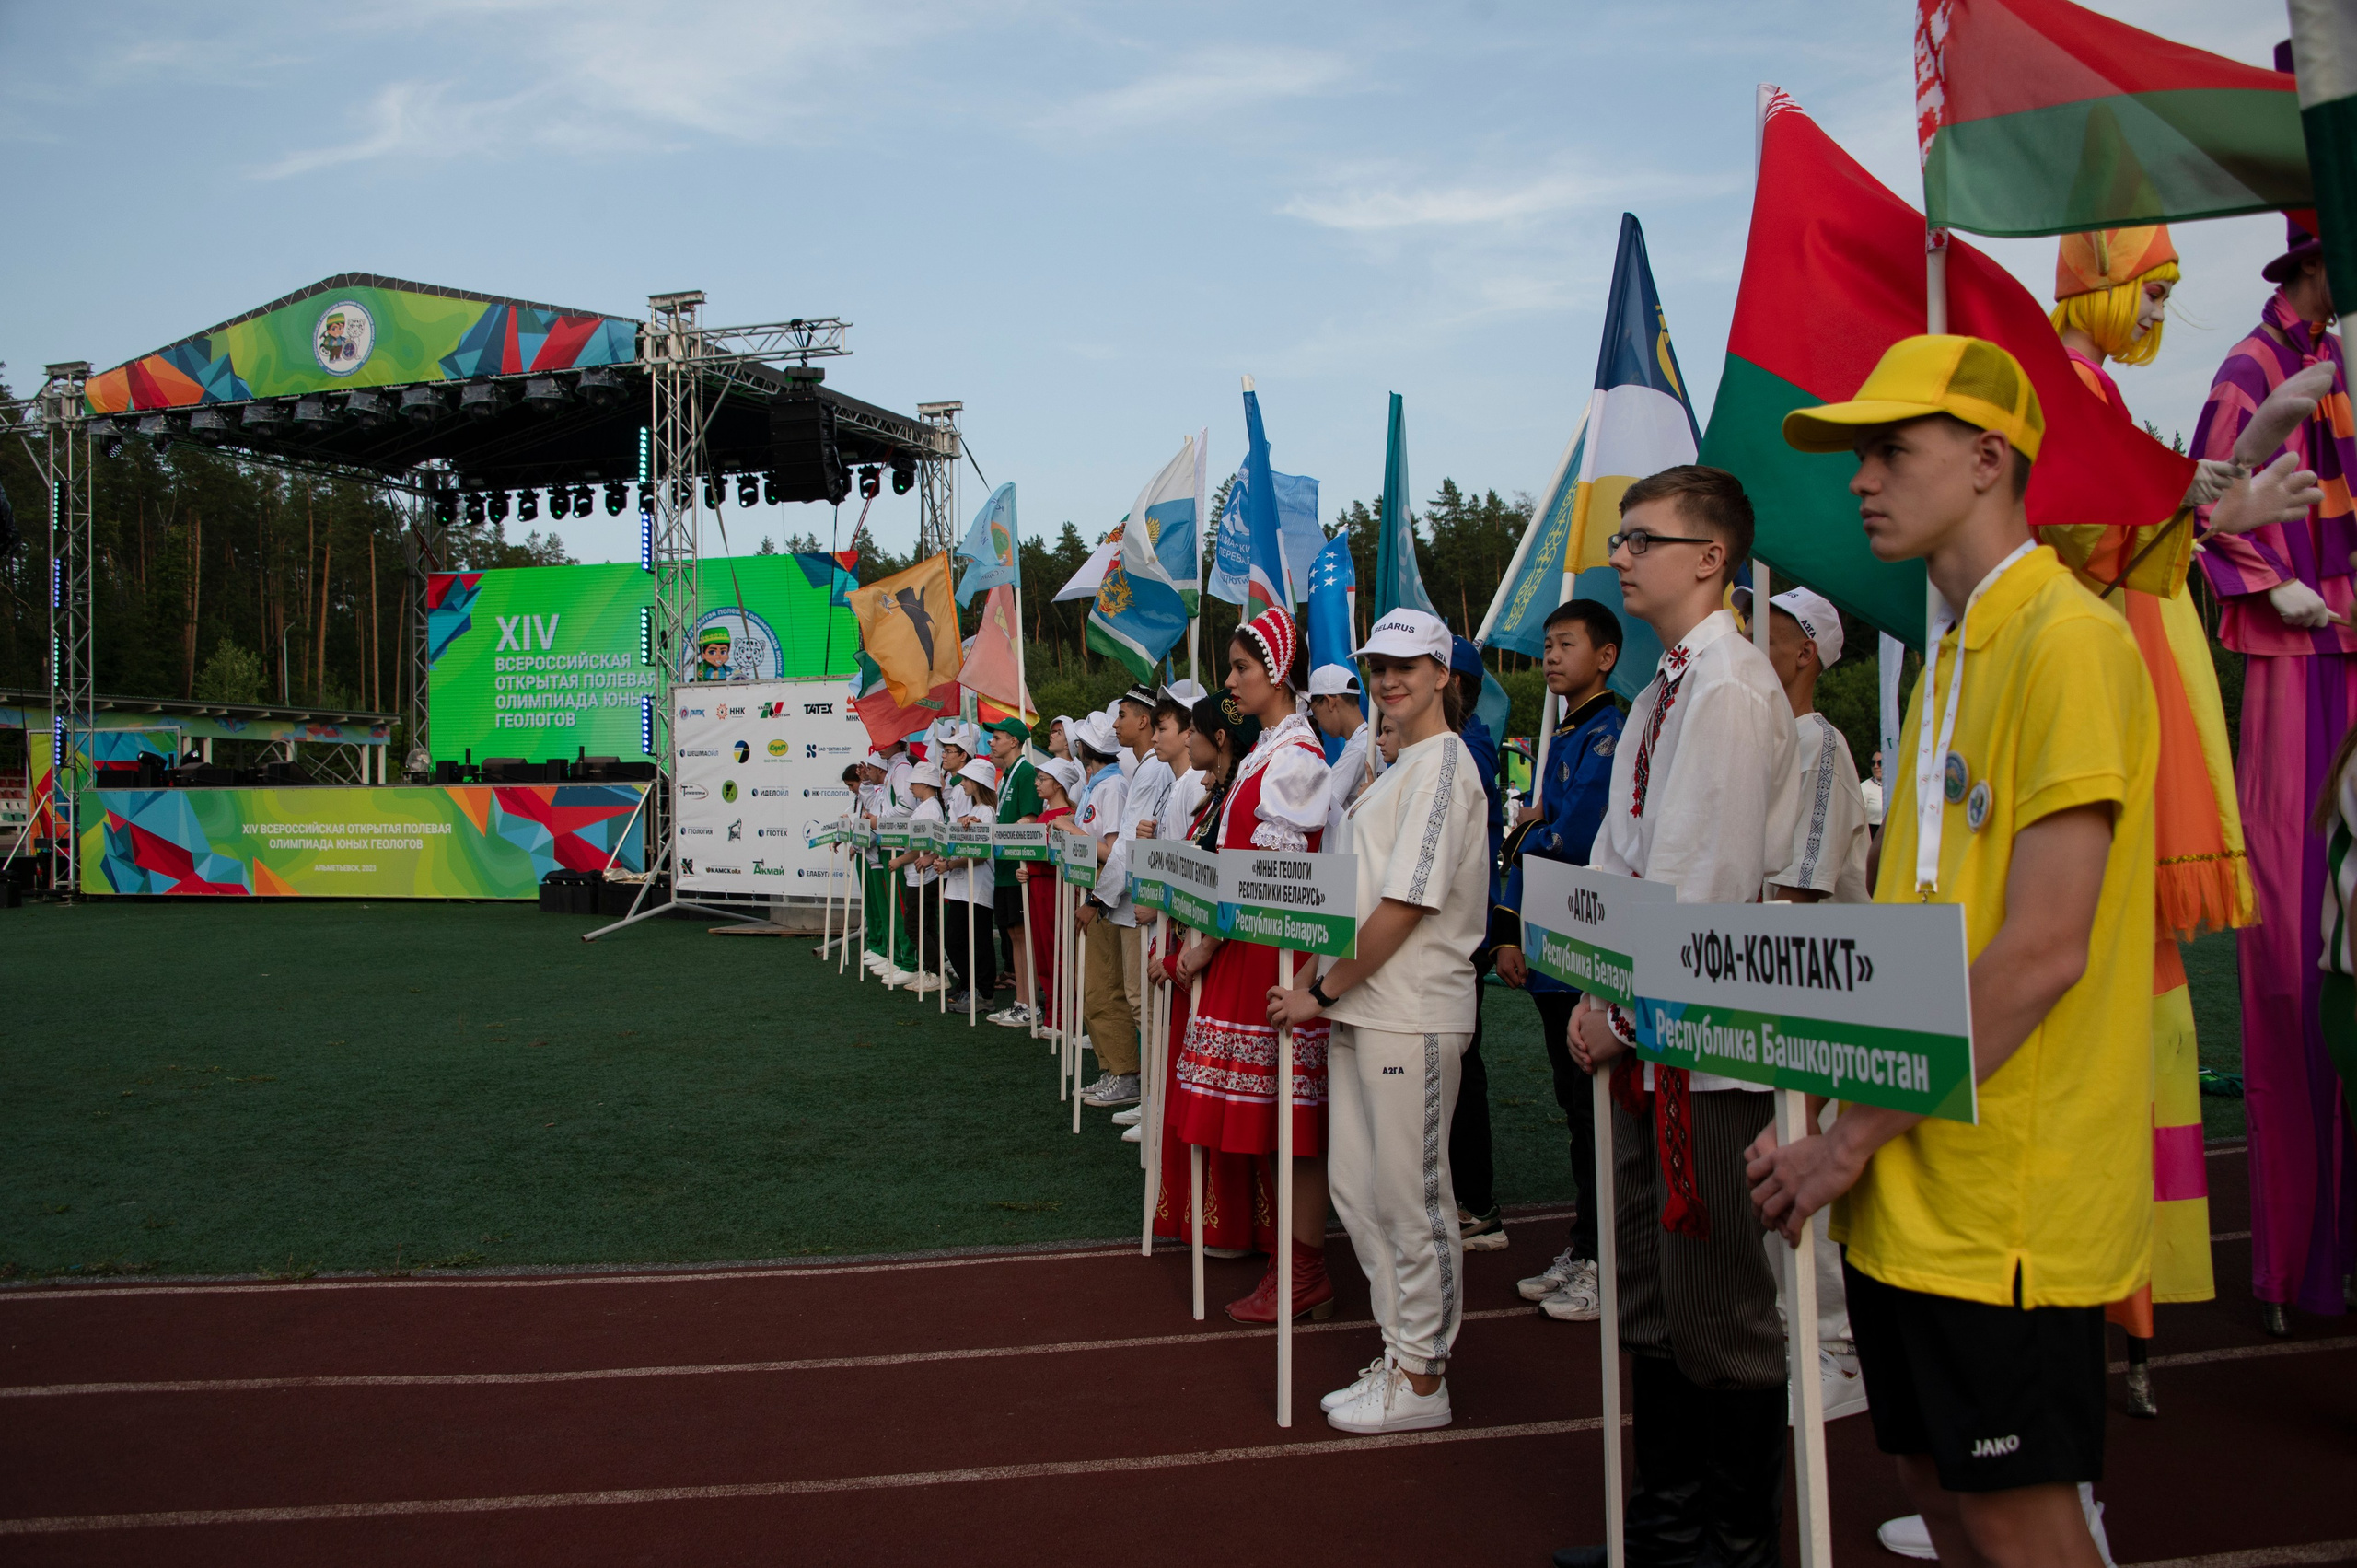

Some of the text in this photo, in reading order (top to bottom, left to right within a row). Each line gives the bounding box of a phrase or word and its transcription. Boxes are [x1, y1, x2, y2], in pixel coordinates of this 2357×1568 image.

[495, 613, 560, 653] XIV
[1374, 622, 1415, 634] BELARUS
[495, 651, 632, 672] ВСЕРОССИЙСКАЯ
[495, 671, 656, 691] ОТКРЫТАЯ ПОЛЕВАЯ
[495, 692, 598, 711] ОЛИМПИАДА
[495, 713, 576, 728] ГЕОЛОГОВ
[242, 821, 452, 834] XIV ВСЕРОССИЙСКАЯ ОТКРЫТАЯ ПОЛЕВАЯ
[269, 839, 424, 851] ОЛИМПИАДА ЮНЫХ ГЕОЛОГОВ
[1252, 859, 1312, 880] «ЮНЫЕ ГЕОЛОГИ
[1238, 880, 1326, 907] РЕСПУБЛИКИ БЕЛАРУСЬ»
[1567, 888, 1606, 926] «АГАТ»
[1235, 908, 1329, 947] Республика Беларусь
[1542, 934, 1632, 1001] Республика Белару
[1680, 929, 1874, 992] «УФА-КОНТАКТ»
[1655, 1008, 1930, 1093] Республика Башкортостан
[1970, 1434, 2021, 1458] JAKO
